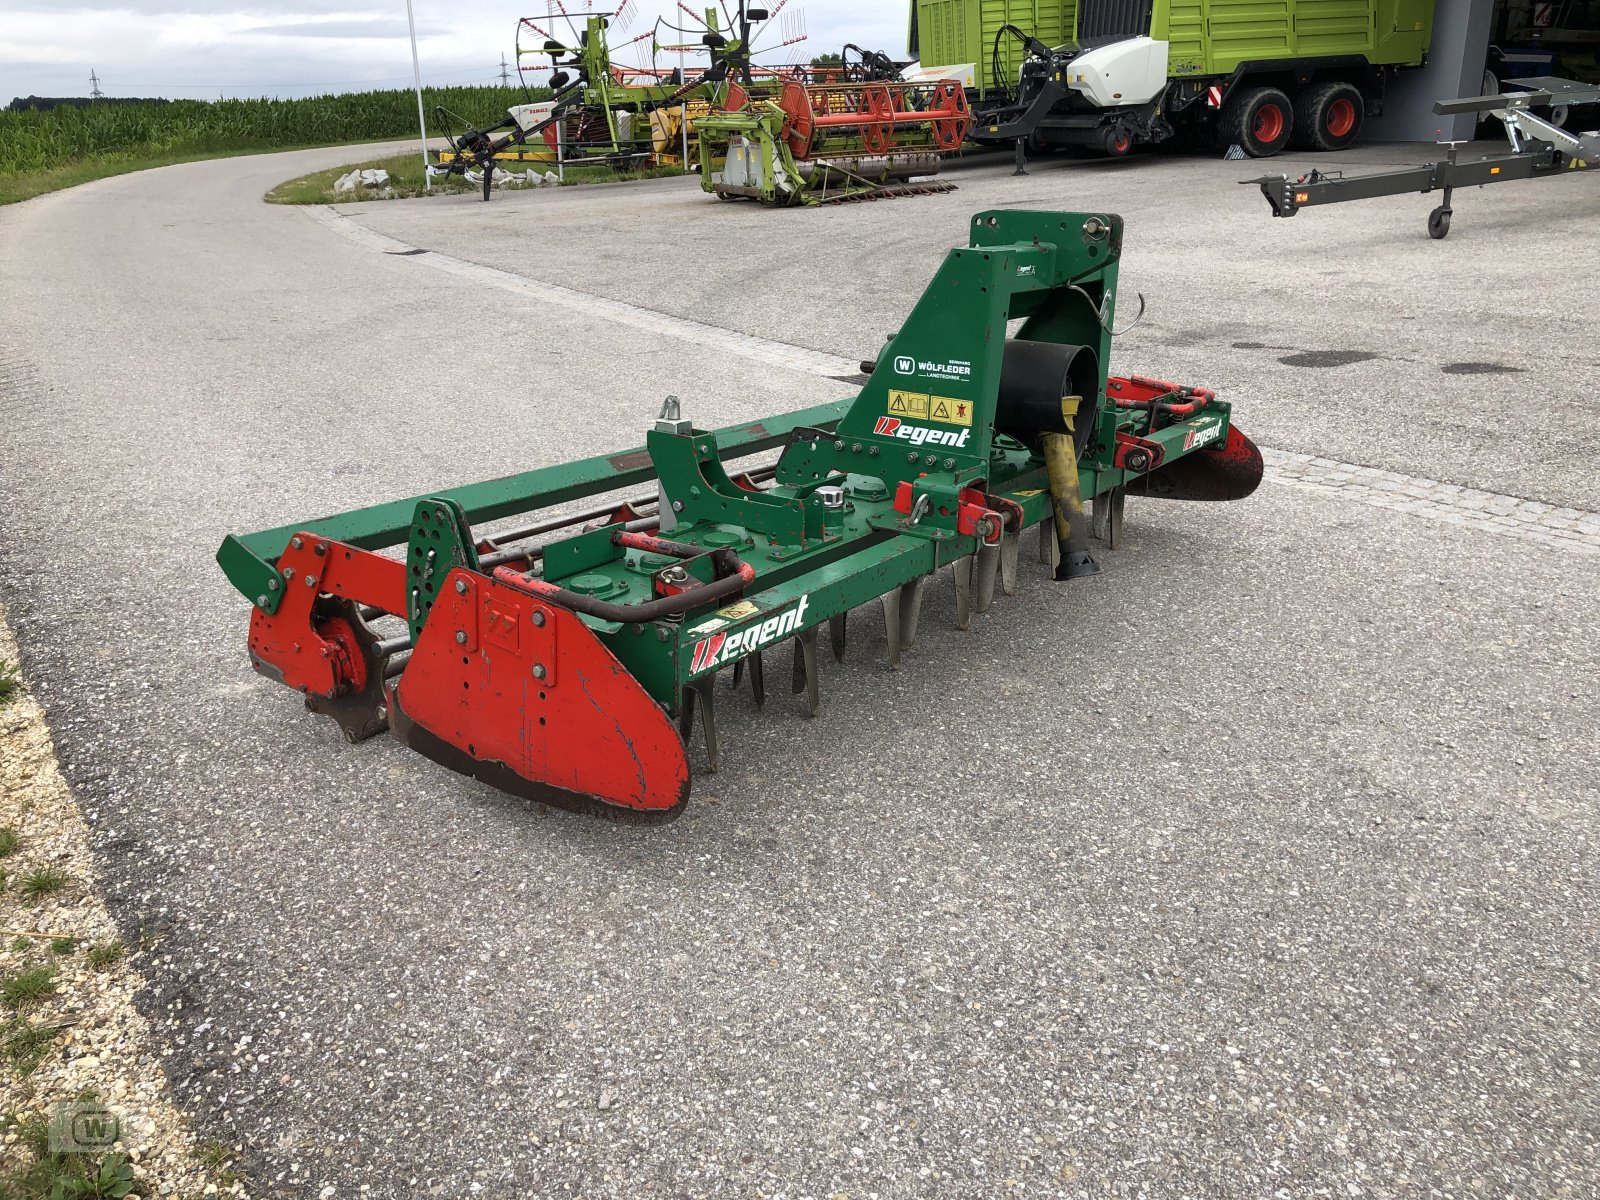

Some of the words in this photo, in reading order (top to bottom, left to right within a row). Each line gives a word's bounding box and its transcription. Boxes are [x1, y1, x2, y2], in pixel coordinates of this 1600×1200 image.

[899, 360, 911, 371] W
[918, 361, 971, 375] WÖLFLEDER
[926, 372, 961, 381] LANDTECHNIK
[873, 416, 970, 447] Regent
[1182, 417, 1222, 452] Regent
[688, 594, 809, 677] Regent
